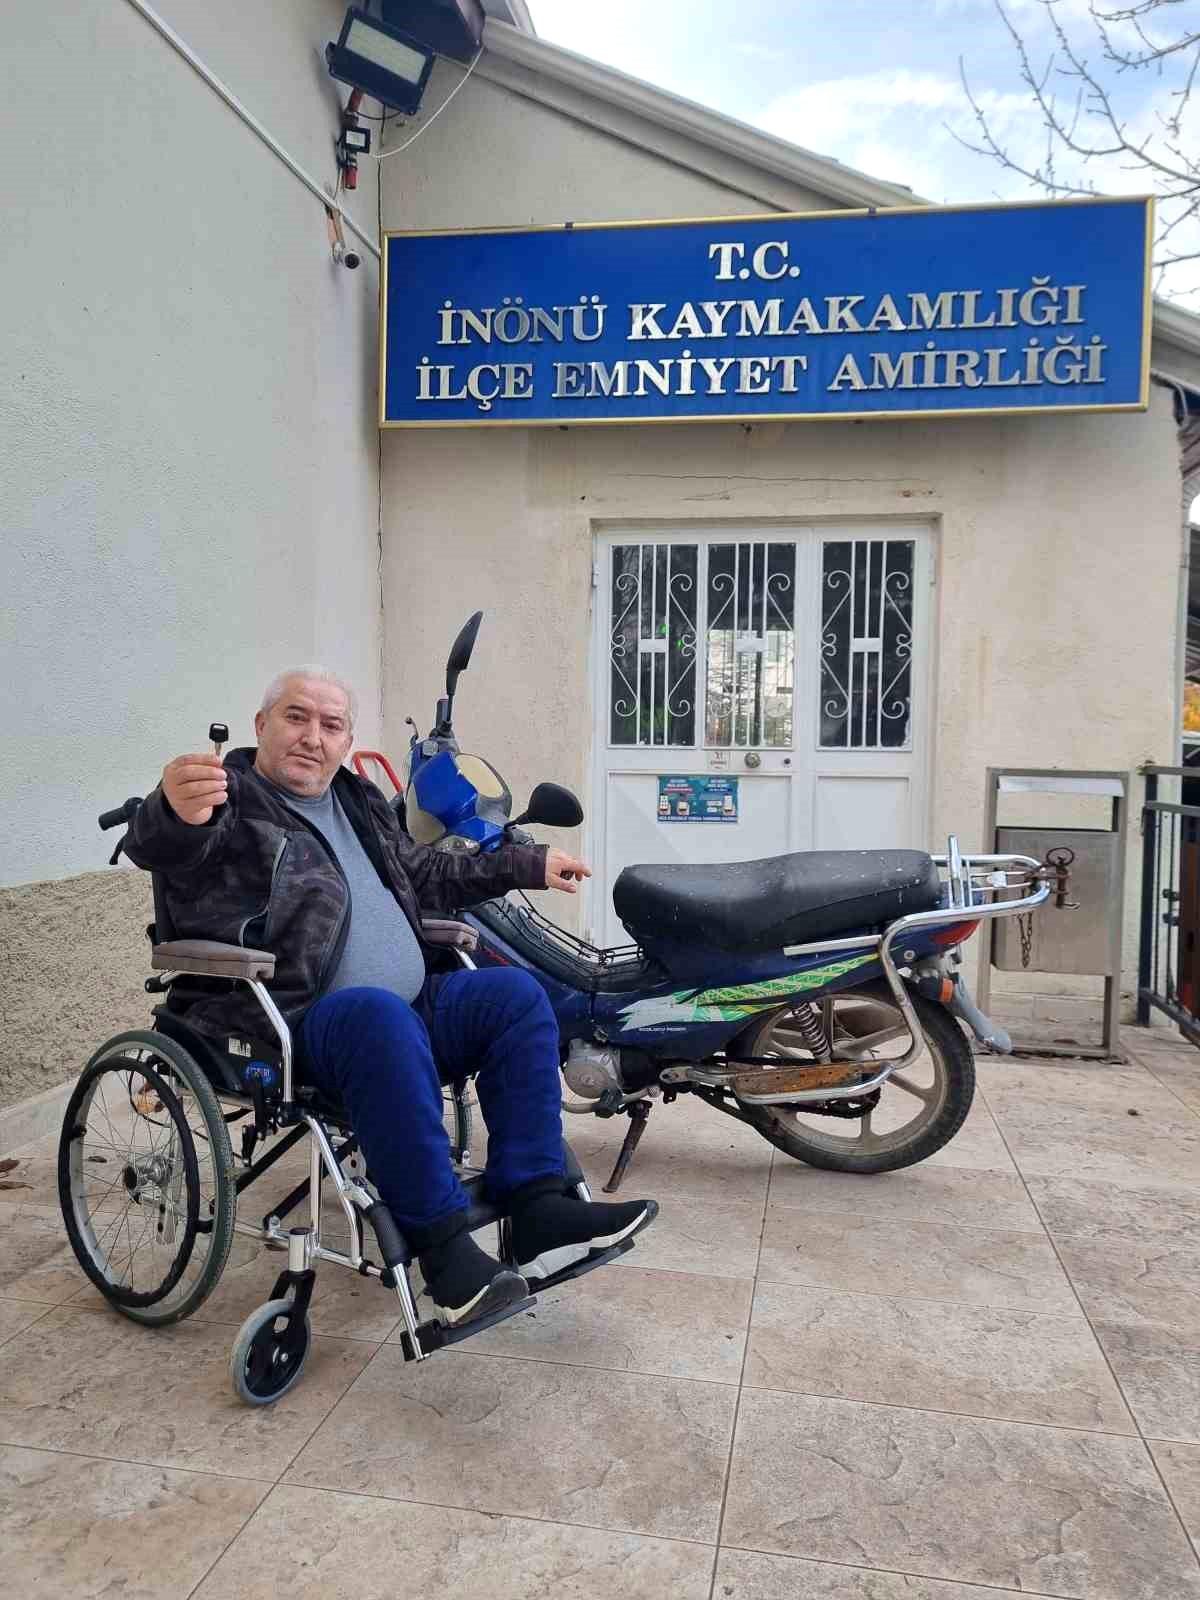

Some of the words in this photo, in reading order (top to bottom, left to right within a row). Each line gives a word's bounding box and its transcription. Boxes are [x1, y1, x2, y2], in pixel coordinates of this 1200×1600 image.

[708, 241, 801, 280] T.C.
[436, 294, 608, 345] İNÖNÜ
[627, 276, 1087, 342] KAYMAKAMLIĞI
[415, 356, 534, 411] İLÇE
[551, 349, 808, 399] EMNİYET
[828, 334, 1107, 391] AMİRLİĞİ
